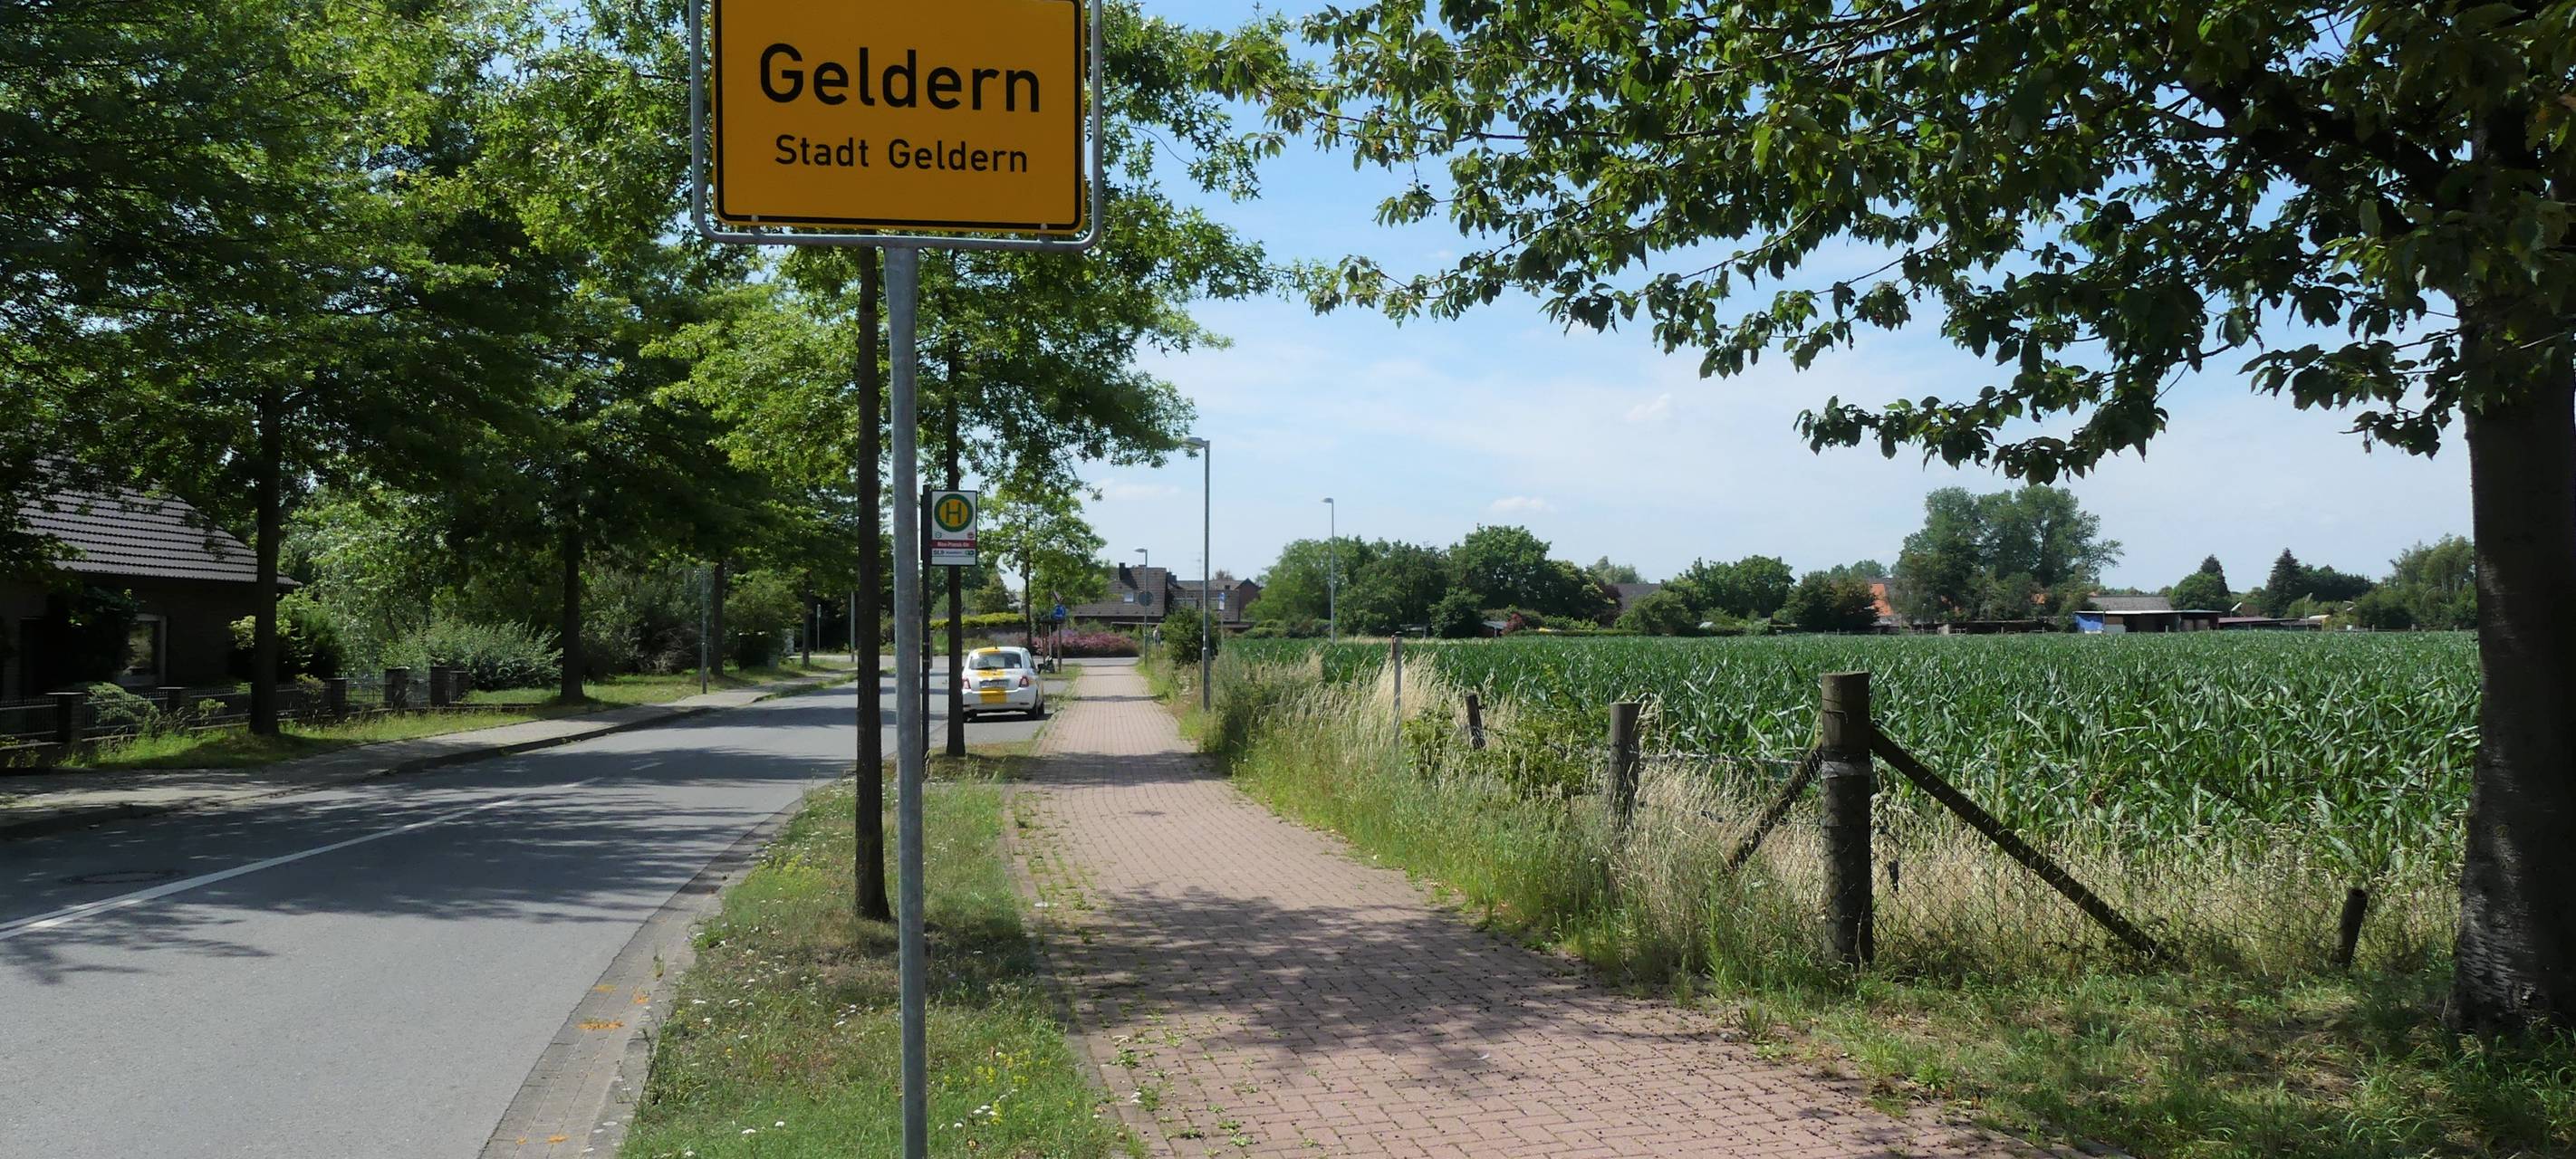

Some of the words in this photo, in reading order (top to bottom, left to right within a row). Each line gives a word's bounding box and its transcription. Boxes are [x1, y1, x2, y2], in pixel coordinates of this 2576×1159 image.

[760, 43, 1040, 112] Geldern
[775, 134, 870, 168] Stadt
[889, 139, 1028, 173] Geldern
[946, 502, 962, 523] H
